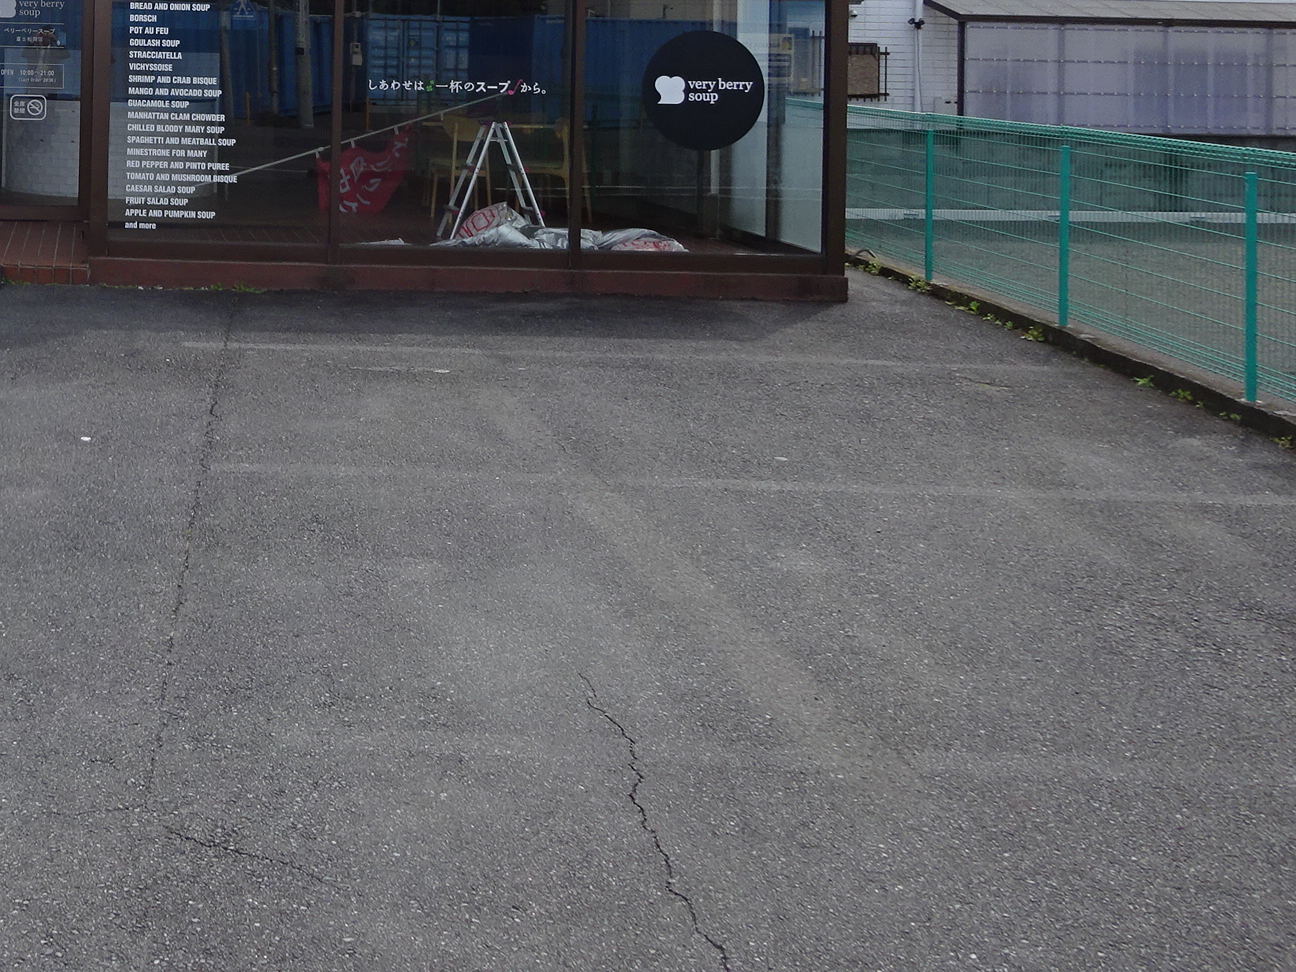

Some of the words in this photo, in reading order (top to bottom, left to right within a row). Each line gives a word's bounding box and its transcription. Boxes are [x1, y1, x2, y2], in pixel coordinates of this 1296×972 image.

[19, 0, 38, 8] very
[41, 0, 65, 9] berry
[130, 2, 152, 10] BREAD
[154, 3, 168, 11] AND
[170, 3, 190, 11] ONION
[192, 3, 210, 11] SOUP
[156, 27, 169, 35] FEU
[129, 39, 160, 47] GOULASH
[129, 51, 182, 60] STRACCIATELLA
[129, 63, 172, 71] VICHYSSOISE
[129, 75, 155, 83] SHRIMP
[157, 76, 171, 84] AND
[172, 76, 191, 84] CRAB
[193, 77, 217, 85] BISQUE
[688, 79, 716, 93] very
[718, 77, 753, 93] berry
[129, 87, 153, 95] MANGO
[155, 88, 169, 96] AND
[170, 88, 202, 97] AVOCADO
[204, 89, 222, 97] SOUP
[688, 90, 719, 104] soup
[128, 99, 169, 108] GUACAMOLE
[171, 100, 189, 108] SOUP
[128, 112, 169, 120] MANHATTAN
[170, 113, 190, 121] CLAM
[192, 113, 225, 122] CHOWDER
[127, 124, 155, 132] CHILLED
[156, 125, 183, 133] BLOODY
[184, 125, 205, 133] MARY
[206, 126, 225, 134] SOUP
[127, 136, 164, 144] SPAGHETTI
[165, 137, 179, 145] AND
[181, 138, 216, 146] MEATBALL
[127, 149, 170, 157] MINESTRONE
[187, 150, 207, 158] MANY
[127, 160, 140, 168] RED
[142, 161, 168, 169] PEPPER
[170, 161, 184, 169] AND
[186, 162, 206, 170] PINTO
[207, 162, 229, 170] PUREE
[126, 172, 154, 181] TOMATO
[156, 173, 170, 181] AND
[172, 174, 212, 182] MUSHROOM
[213, 175, 237, 183] BISQUE
[126, 185, 152, 193] CAESAR
[154, 185, 176, 193] SALAD
[177, 186, 195, 194] SOUP
[126, 197, 145, 205] FRUIT
[147, 197, 168, 205] SALAD
[170, 198, 188, 206] SOUP
[125, 209, 147, 217] APPLE
[164, 210, 196, 218] PUMPKIN
[197, 211, 215, 219] SOUP
